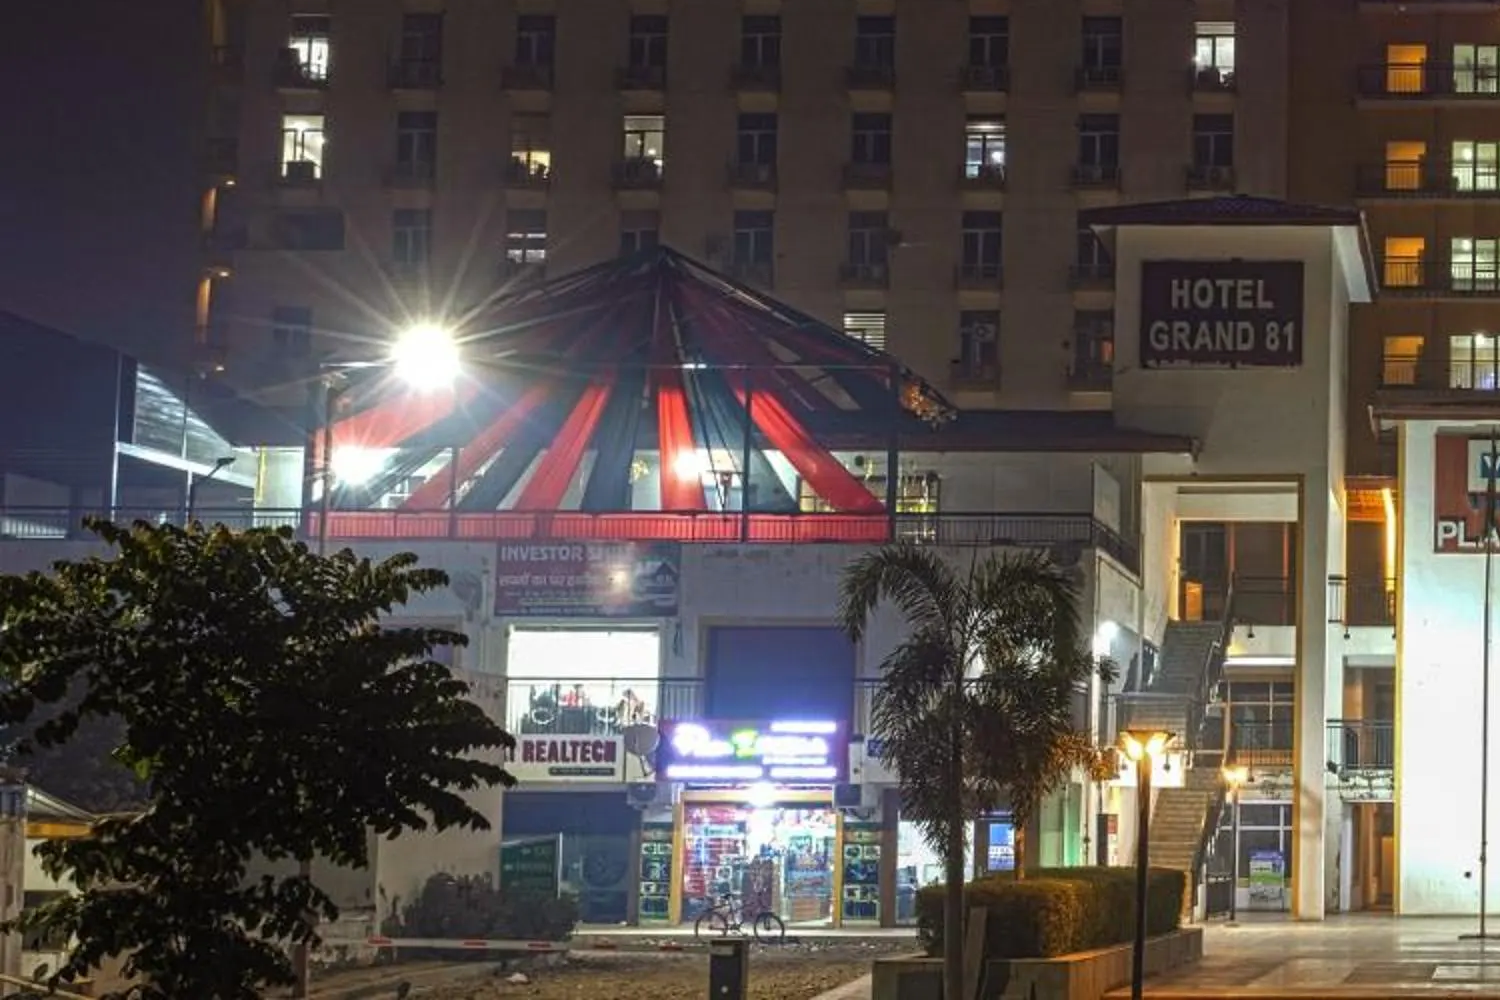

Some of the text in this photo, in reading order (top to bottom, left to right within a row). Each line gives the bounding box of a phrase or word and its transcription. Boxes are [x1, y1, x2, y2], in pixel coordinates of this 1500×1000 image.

[1171, 279, 1274, 309] HOTEL
[1150, 321, 1295, 352] GRAND 81
[501, 545, 584, 562] INVESTOR
